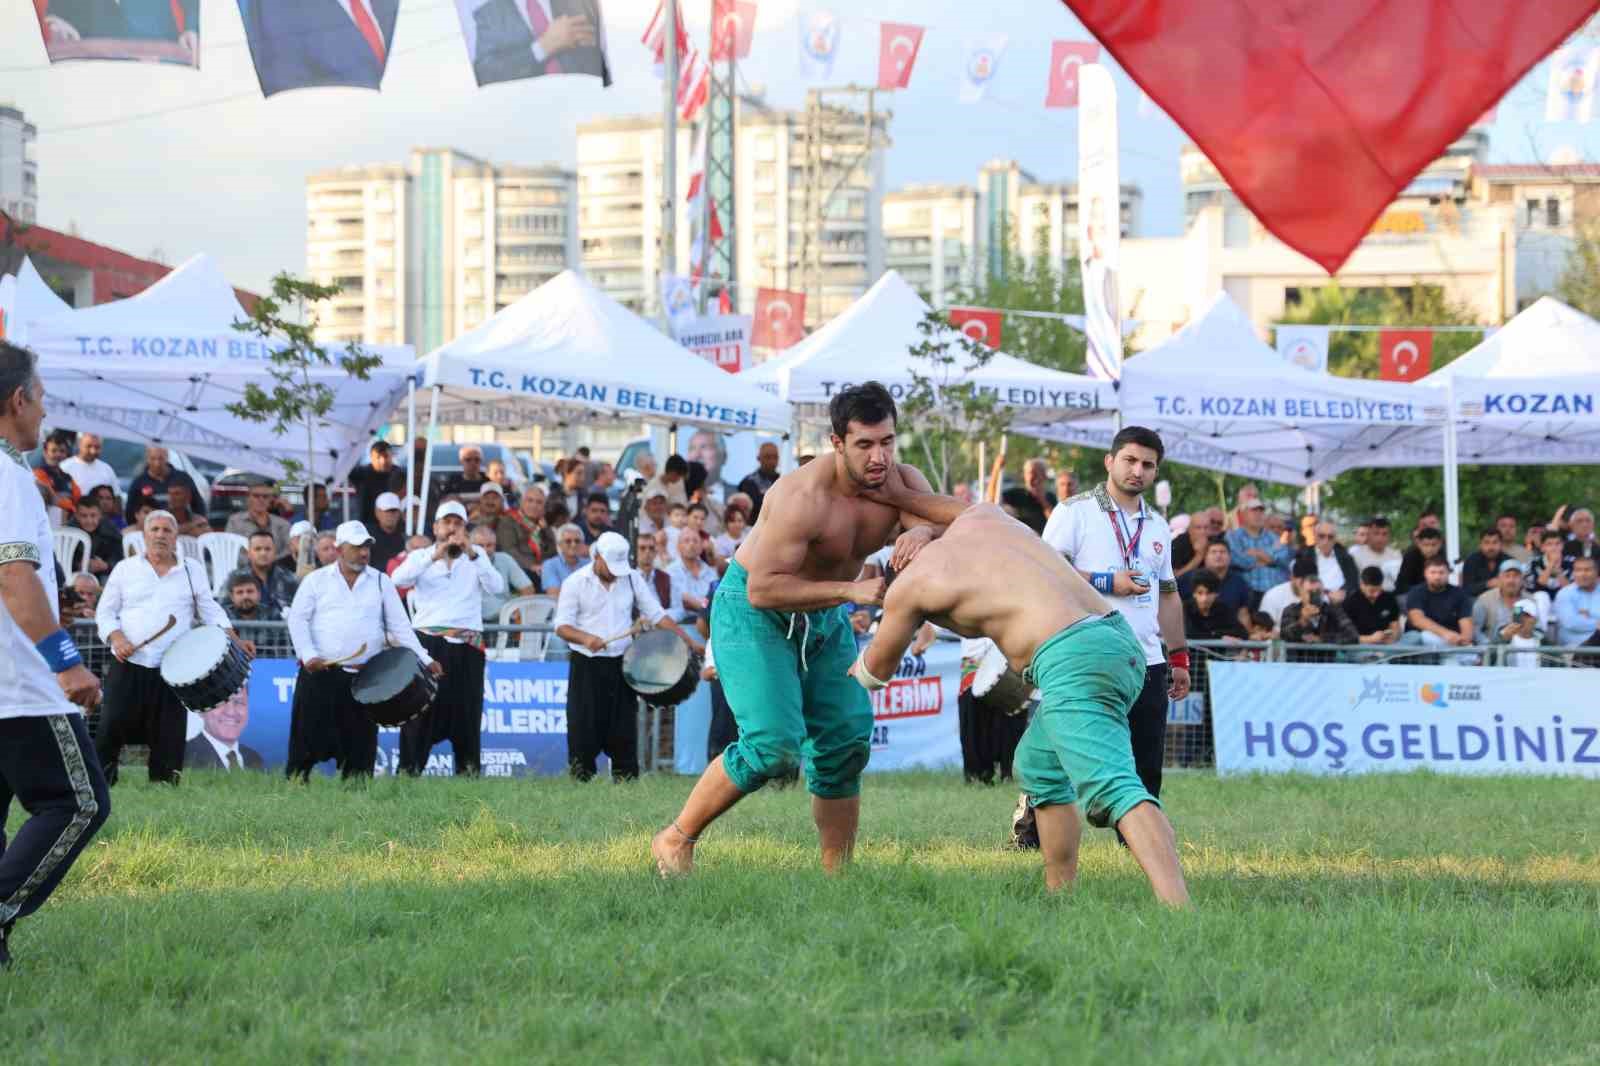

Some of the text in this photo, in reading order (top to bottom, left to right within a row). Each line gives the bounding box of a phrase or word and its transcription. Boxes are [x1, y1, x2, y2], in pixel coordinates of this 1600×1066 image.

[76, 336, 122, 355] T.C.
[131, 337, 218, 358] KOZAN
[469, 367, 512, 389] T.C.
[521, 374, 607, 403] KOZAN
[616, 389, 758, 426] BELEDİYESİ
[1154, 396, 1414, 421] T.C. KOZAN BELEDİYESİ
[1485, 394, 1593, 414] KOZAN
[872, 680, 940, 715] İLERİM
[1244, 713, 1600, 768] HOŞ GELDİNİZ
